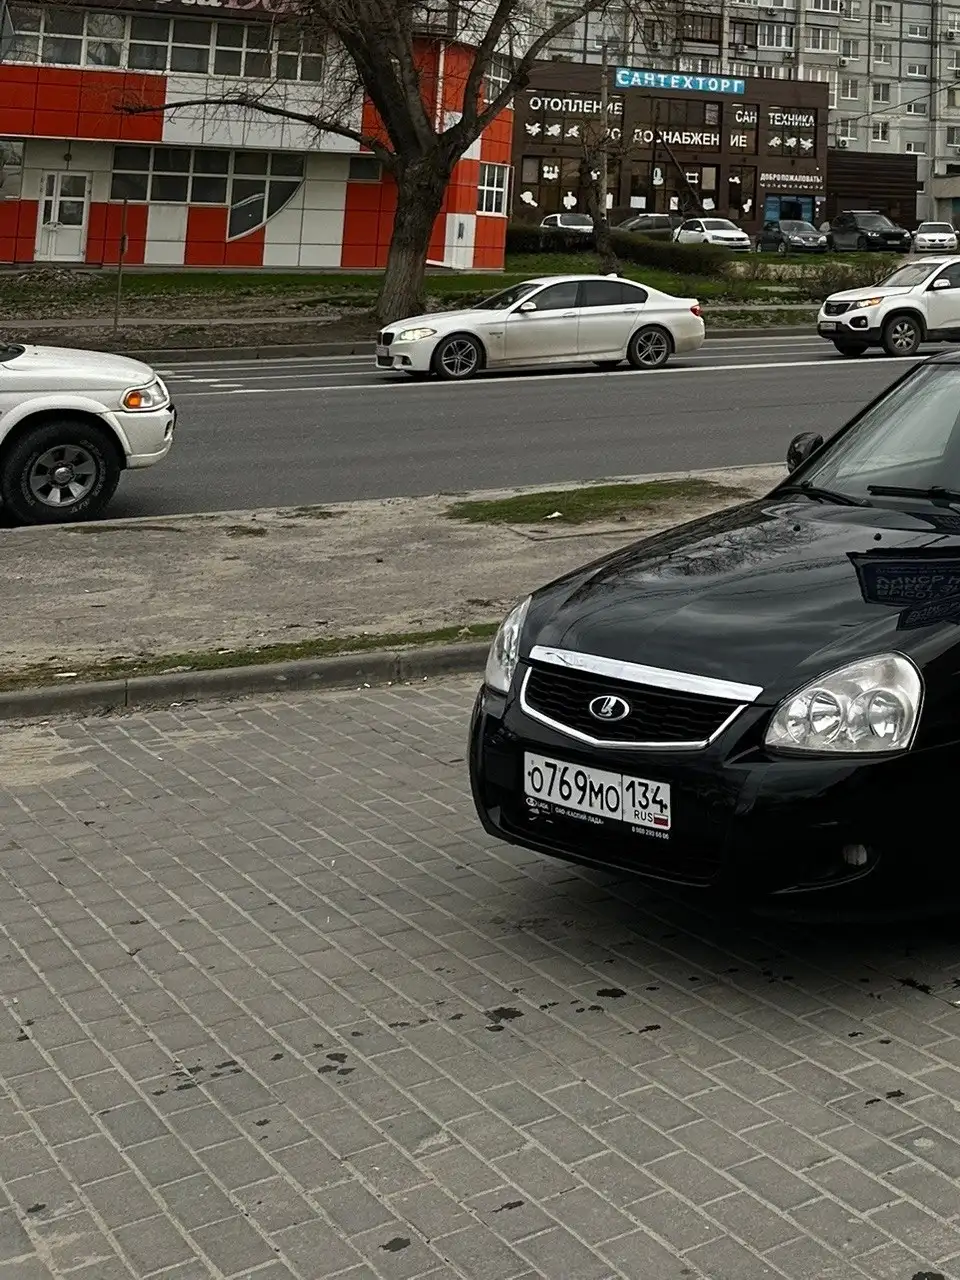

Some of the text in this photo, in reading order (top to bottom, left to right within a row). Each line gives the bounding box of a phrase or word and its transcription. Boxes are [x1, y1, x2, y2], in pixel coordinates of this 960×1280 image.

[616, 69, 745, 93] САНТЕХТОРГ
[735, 110, 758, 124] САН
[767, 112, 816, 127] ТЕХНИКА
[625, 780, 665, 813] 134
[633, 809, 654, 822] RUS
